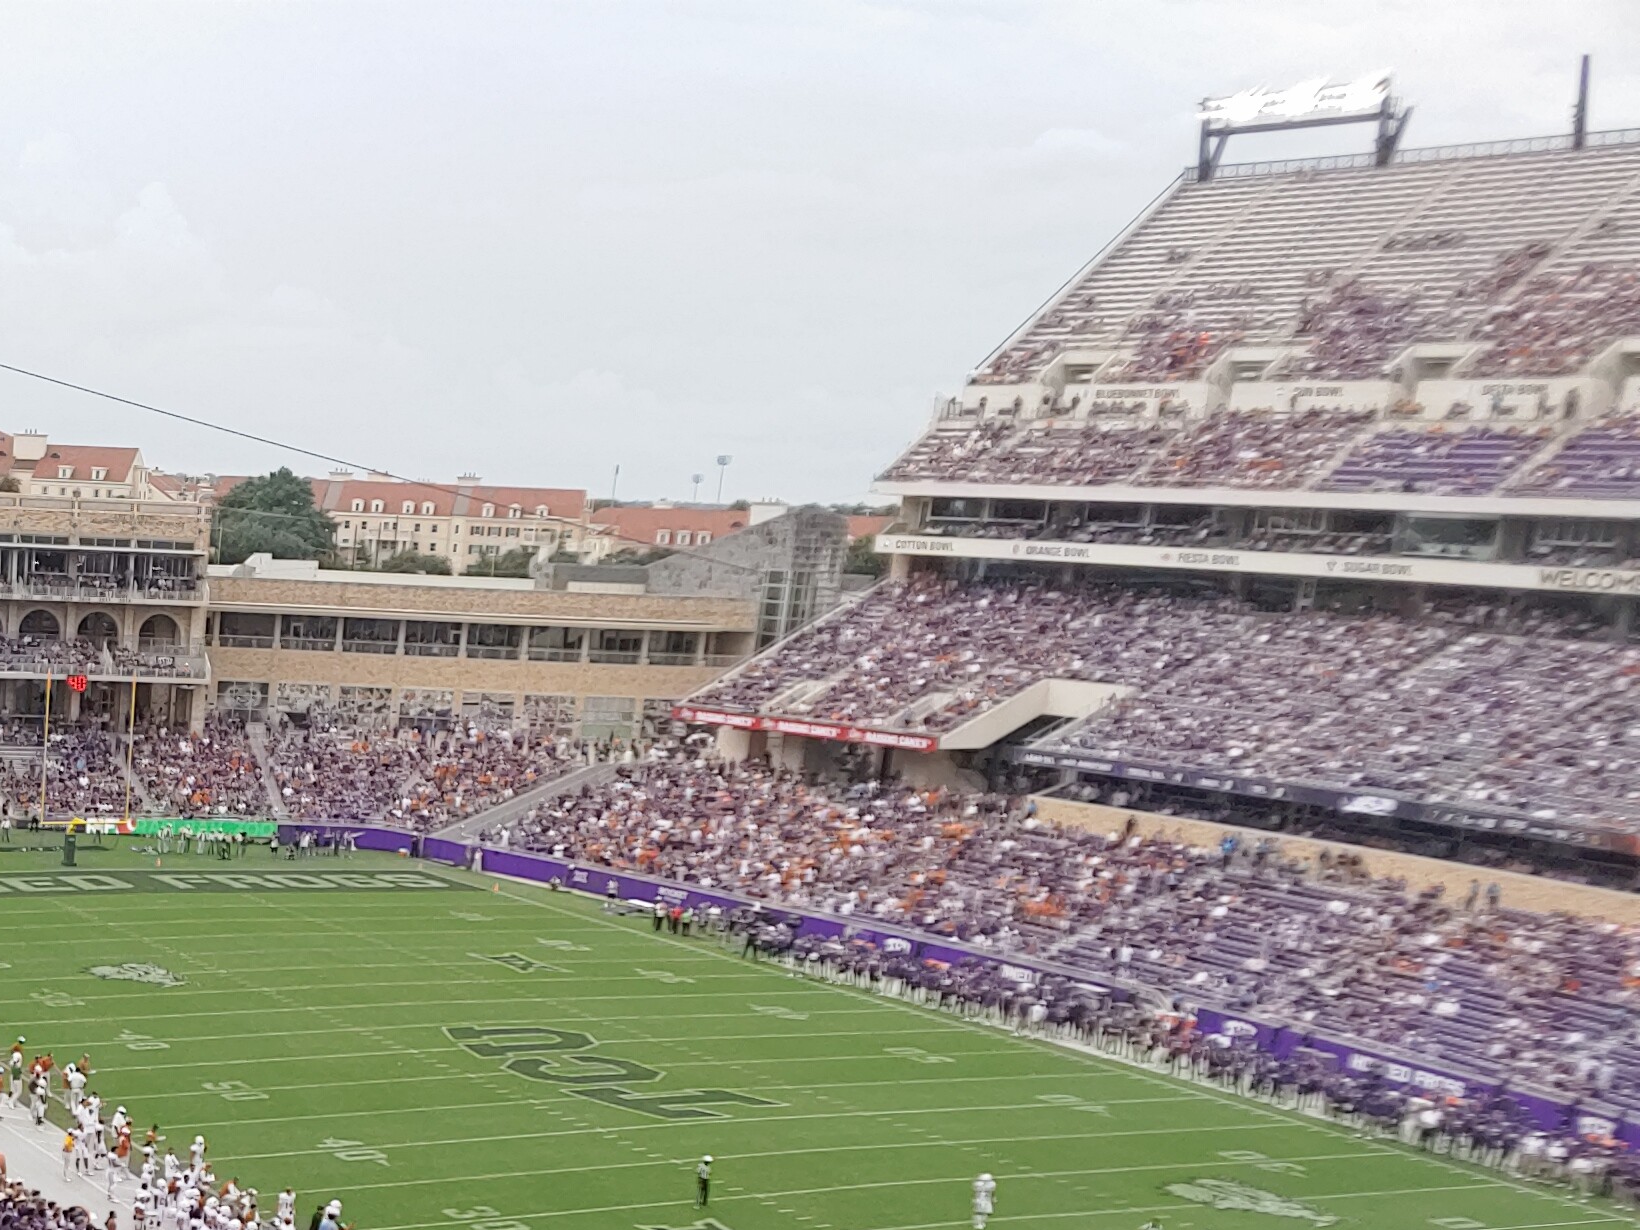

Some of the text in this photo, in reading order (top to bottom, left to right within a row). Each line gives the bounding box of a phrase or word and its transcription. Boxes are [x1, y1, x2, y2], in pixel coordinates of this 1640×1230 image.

[895, 540, 954, 551] COTTON BOWL
[1064, 547, 1090, 558] BOWL
[1211, 554, 1240, 565] BOWL
[1382, 564, 1414, 575] BOWL
[67, 675, 87, 692] 40
[149, 873, 451, 890] FROGS
[441, 1026, 791, 1120] TCU
[1348, 1053, 1412, 1083] HOED
[316, 1138, 386, 1163] 40
